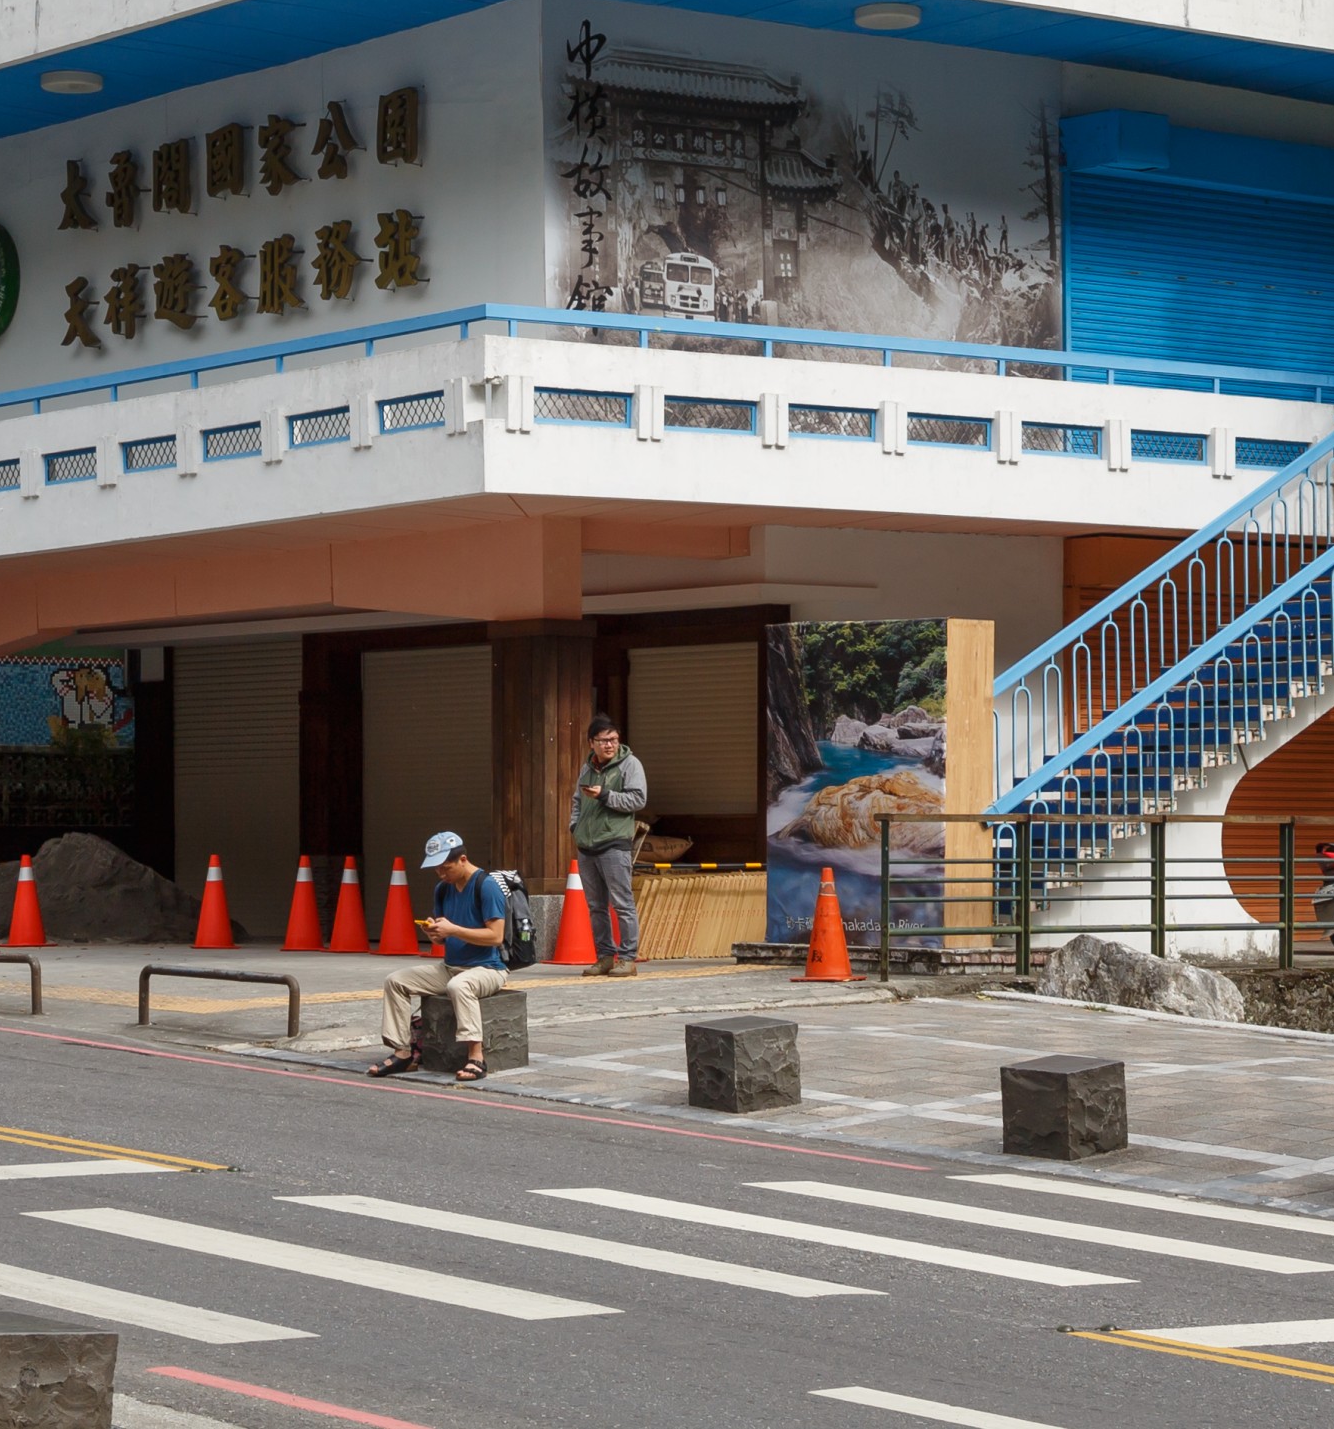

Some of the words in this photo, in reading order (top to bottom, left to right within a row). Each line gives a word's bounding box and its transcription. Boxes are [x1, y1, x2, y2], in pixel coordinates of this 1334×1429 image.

[58, 86, 419, 231] 太魯閣國家公園
[61, 209, 420, 349] 天祥遊客服務站
